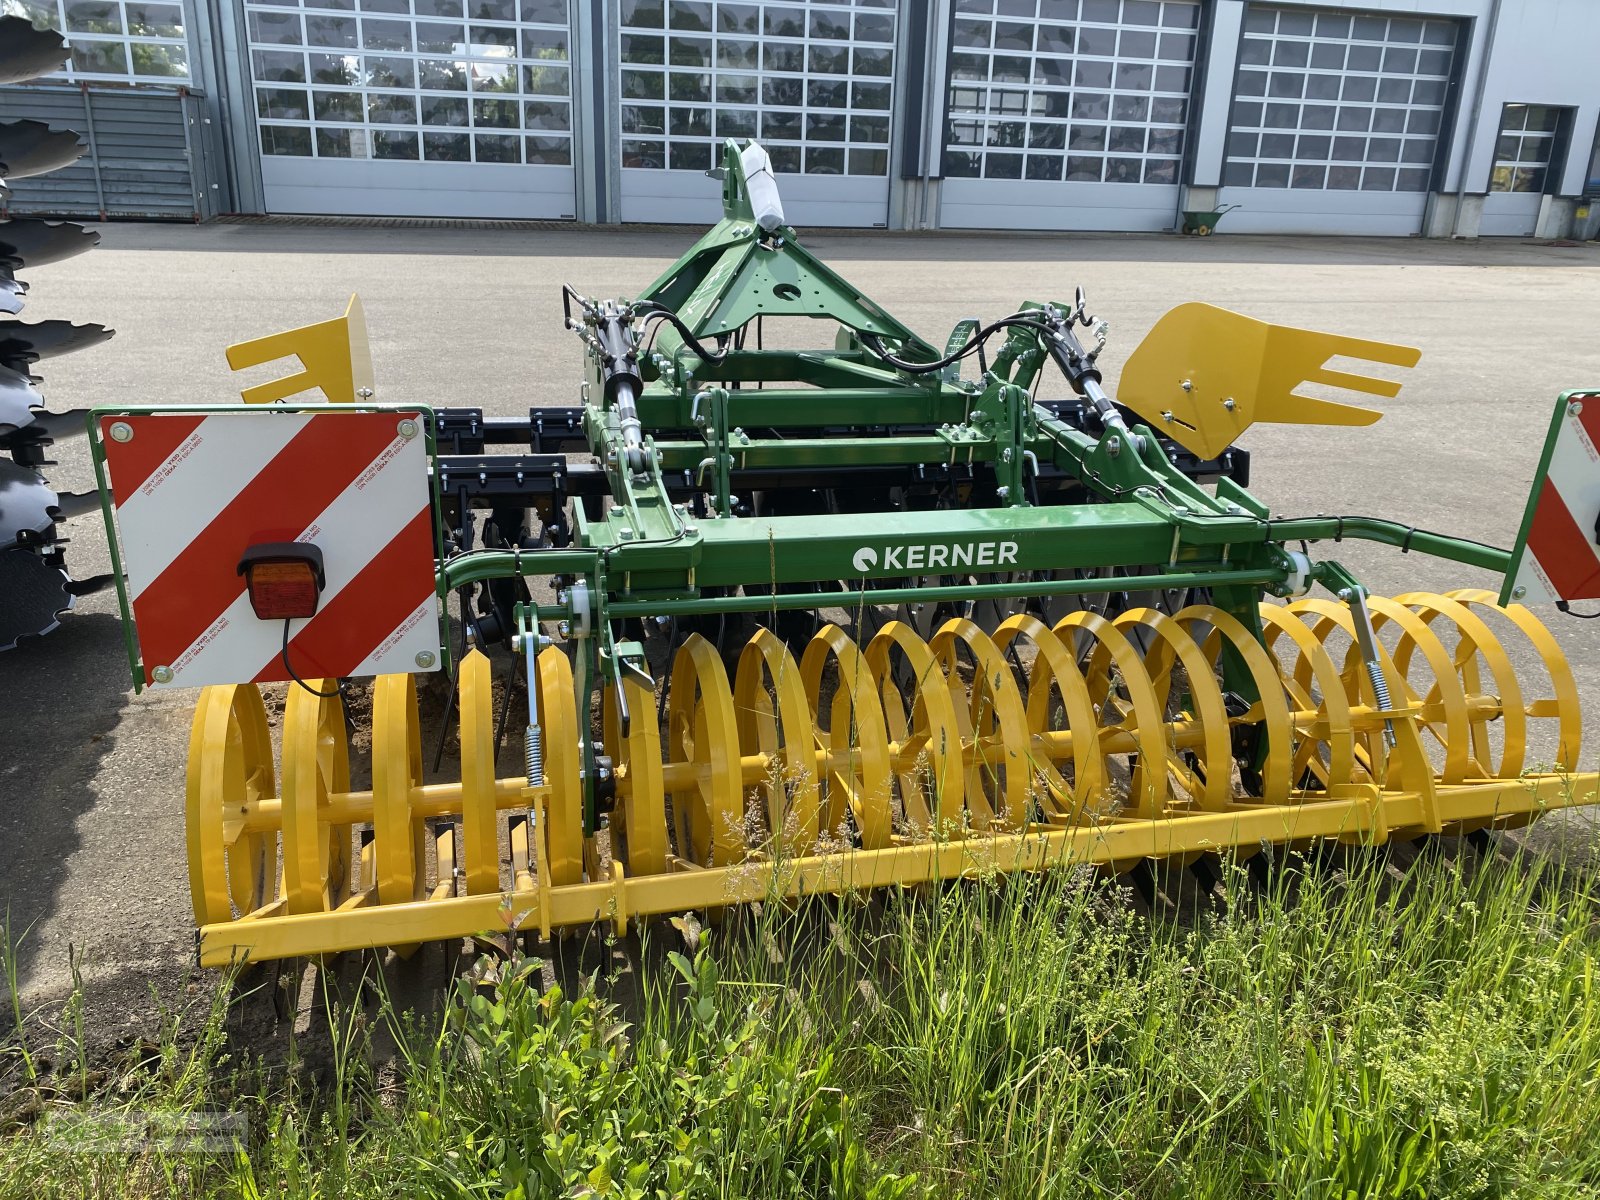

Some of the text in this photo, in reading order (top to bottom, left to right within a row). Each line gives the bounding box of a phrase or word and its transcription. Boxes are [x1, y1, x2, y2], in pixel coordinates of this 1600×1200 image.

[167, 453, 179, 465] GEKA
[379, 448, 391, 461] GEKA
[164, 464, 176, 476] GEKA
[376, 459, 388, 471] GEKA
[884, 541, 1018, 570] KERNER
